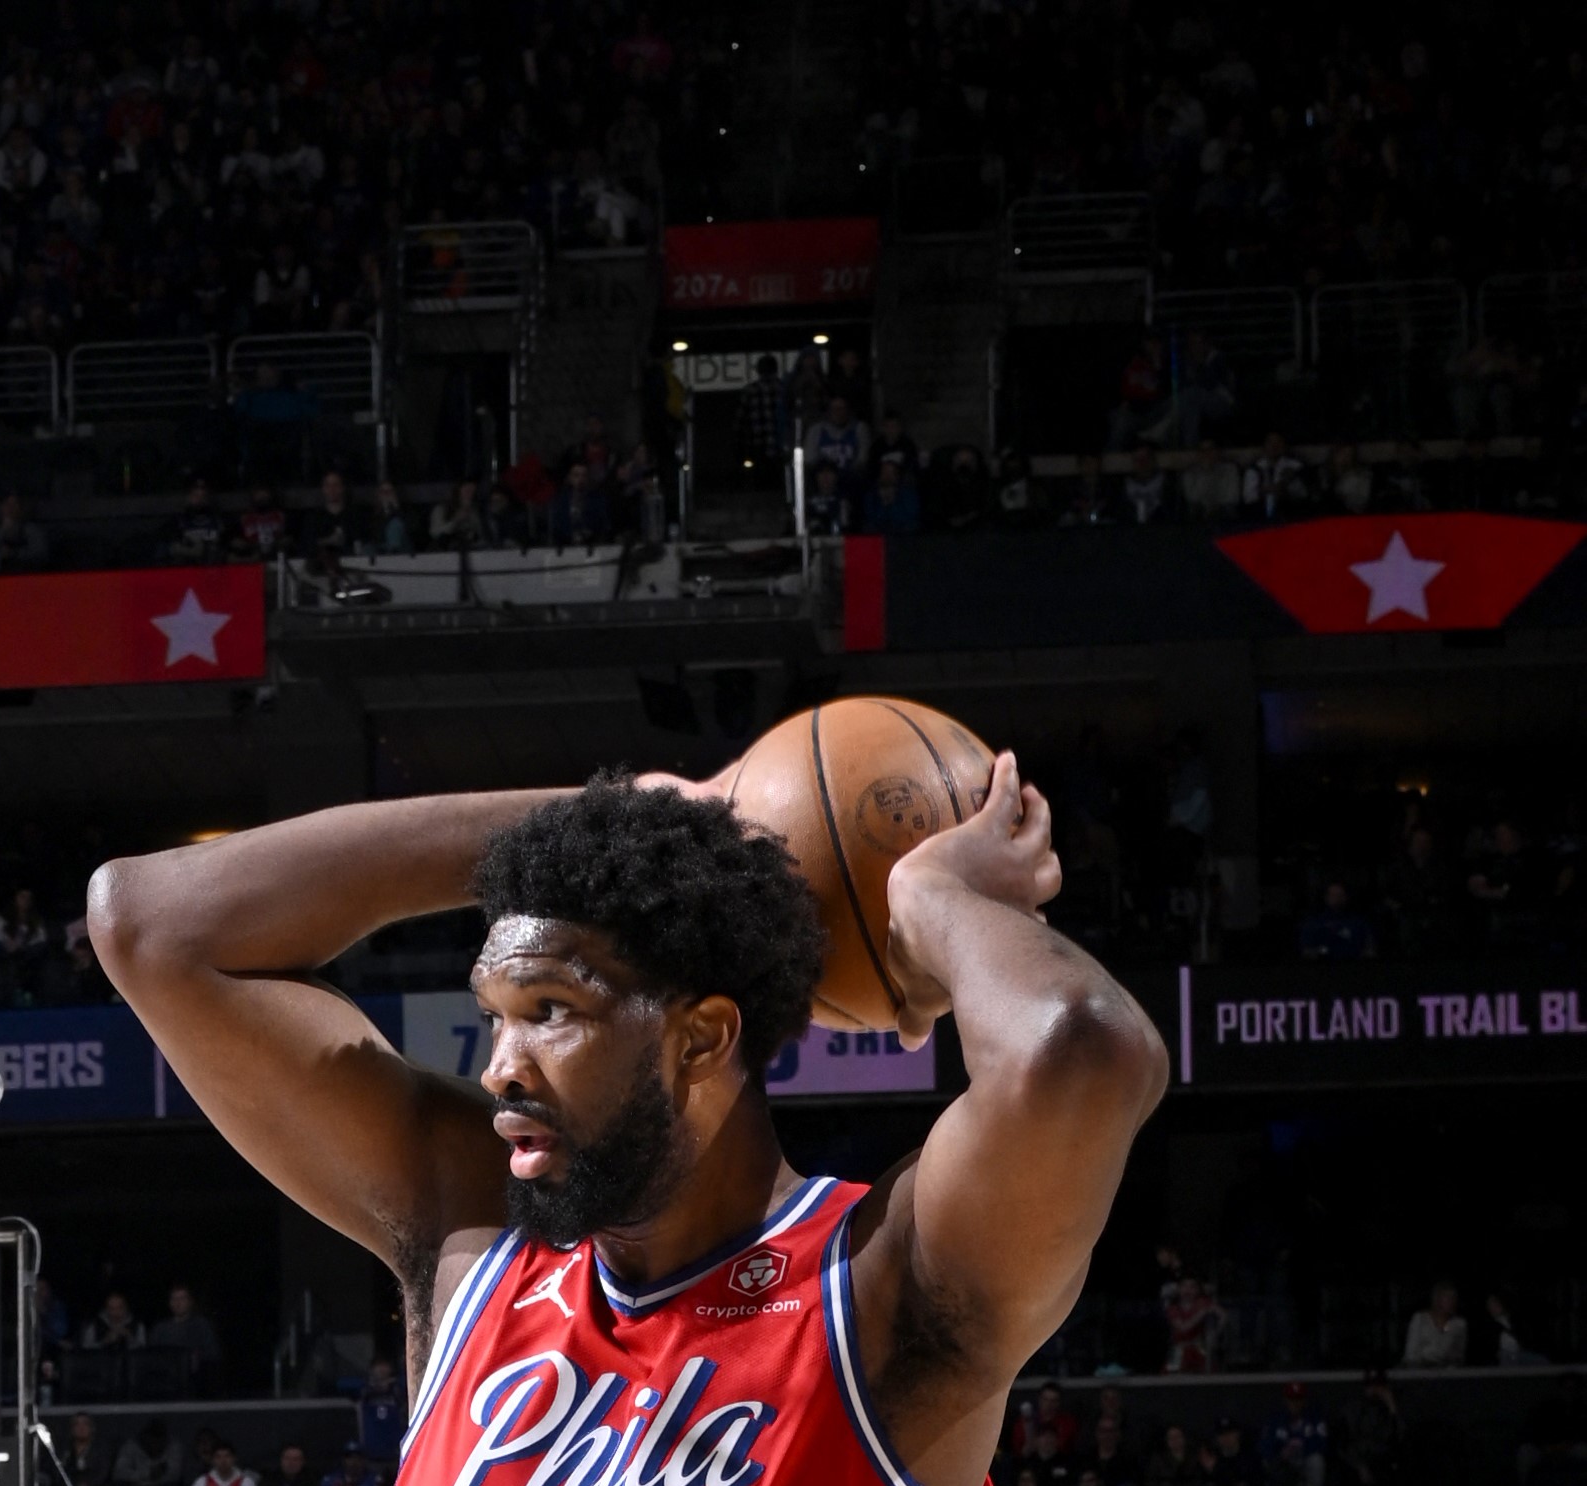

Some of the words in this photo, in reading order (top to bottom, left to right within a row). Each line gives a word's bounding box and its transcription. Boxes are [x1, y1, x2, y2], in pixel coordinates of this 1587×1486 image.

[672, 273, 742, 299] 207A
[820, 266, 873, 293] 207
[1217, 997, 1400, 1043] PORTLAND
[1417, 994, 1529, 1037] TRAIL
[1539, 990, 1587, 1033] BL
[696, 1299, 800, 1318] crypto.com
